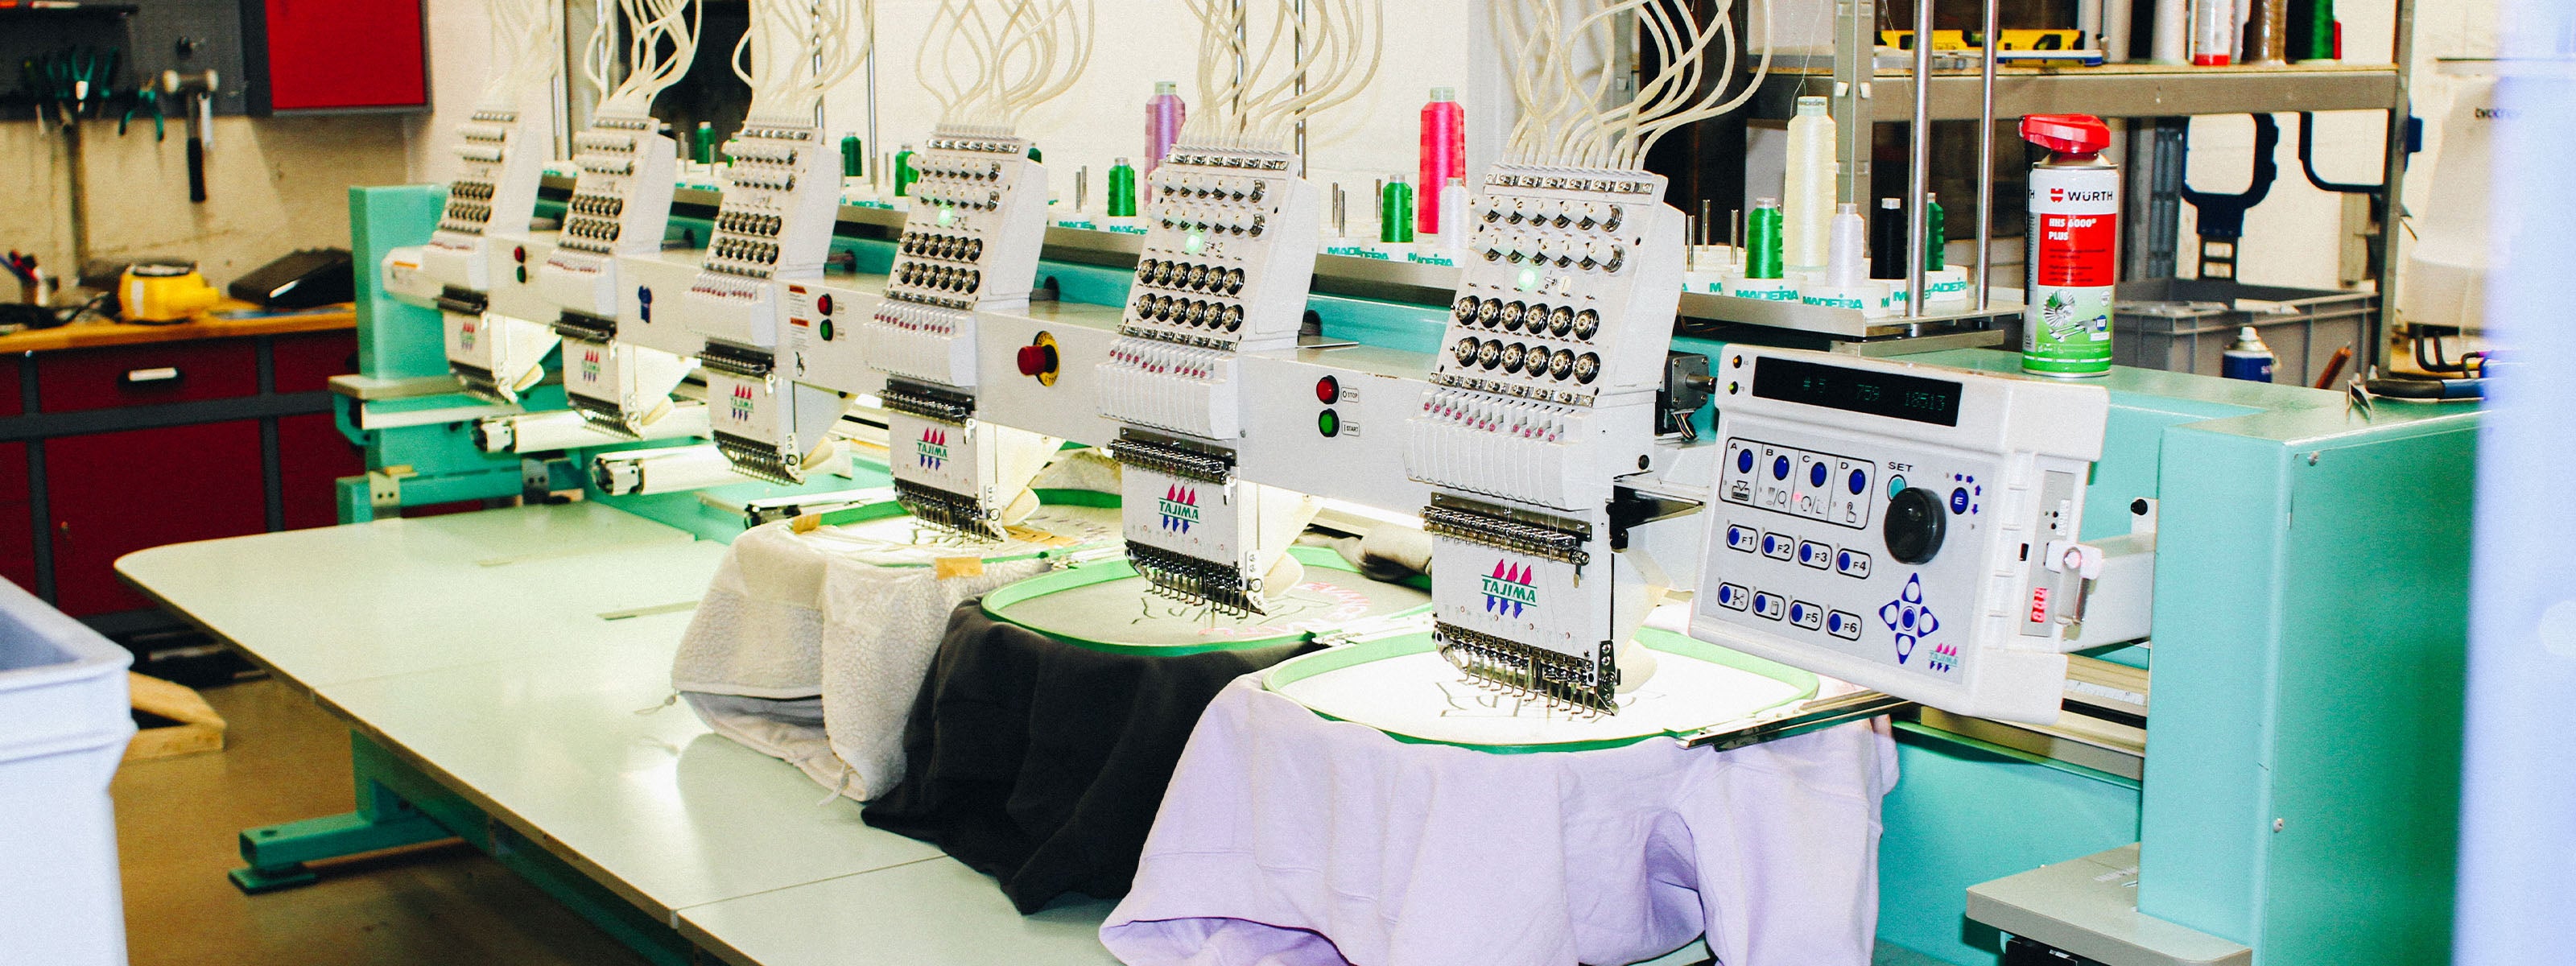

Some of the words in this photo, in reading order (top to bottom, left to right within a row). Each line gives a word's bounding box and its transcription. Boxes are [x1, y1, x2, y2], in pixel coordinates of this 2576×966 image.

[2067, 190, 2113, 201] WÜRTH
[2049, 218, 2066, 227] HHS
[2049, 231, 2069, 241] PLUS
[917, 442, 947, 458] TAJIMA
[1766, 448, 1773, 456] B
[1802, 455, 1810, 463] C
[1888, 461, 1913, 472] SET
[1955, 497, 1963, 505] E
[1159, 501, 1199, 520] TAJIMA
[1741, 536, 1753, 545] F1
[1777, 543, 1790, 554] F2
[1814, 552, 1828, 562] F3
[1853, 561, 1867, 571] F4
[1482, 579, 1536, 603] TAJIMA
[1806, 613, 1818, 623] F5
[1843, 622, 1857, 633] F6
